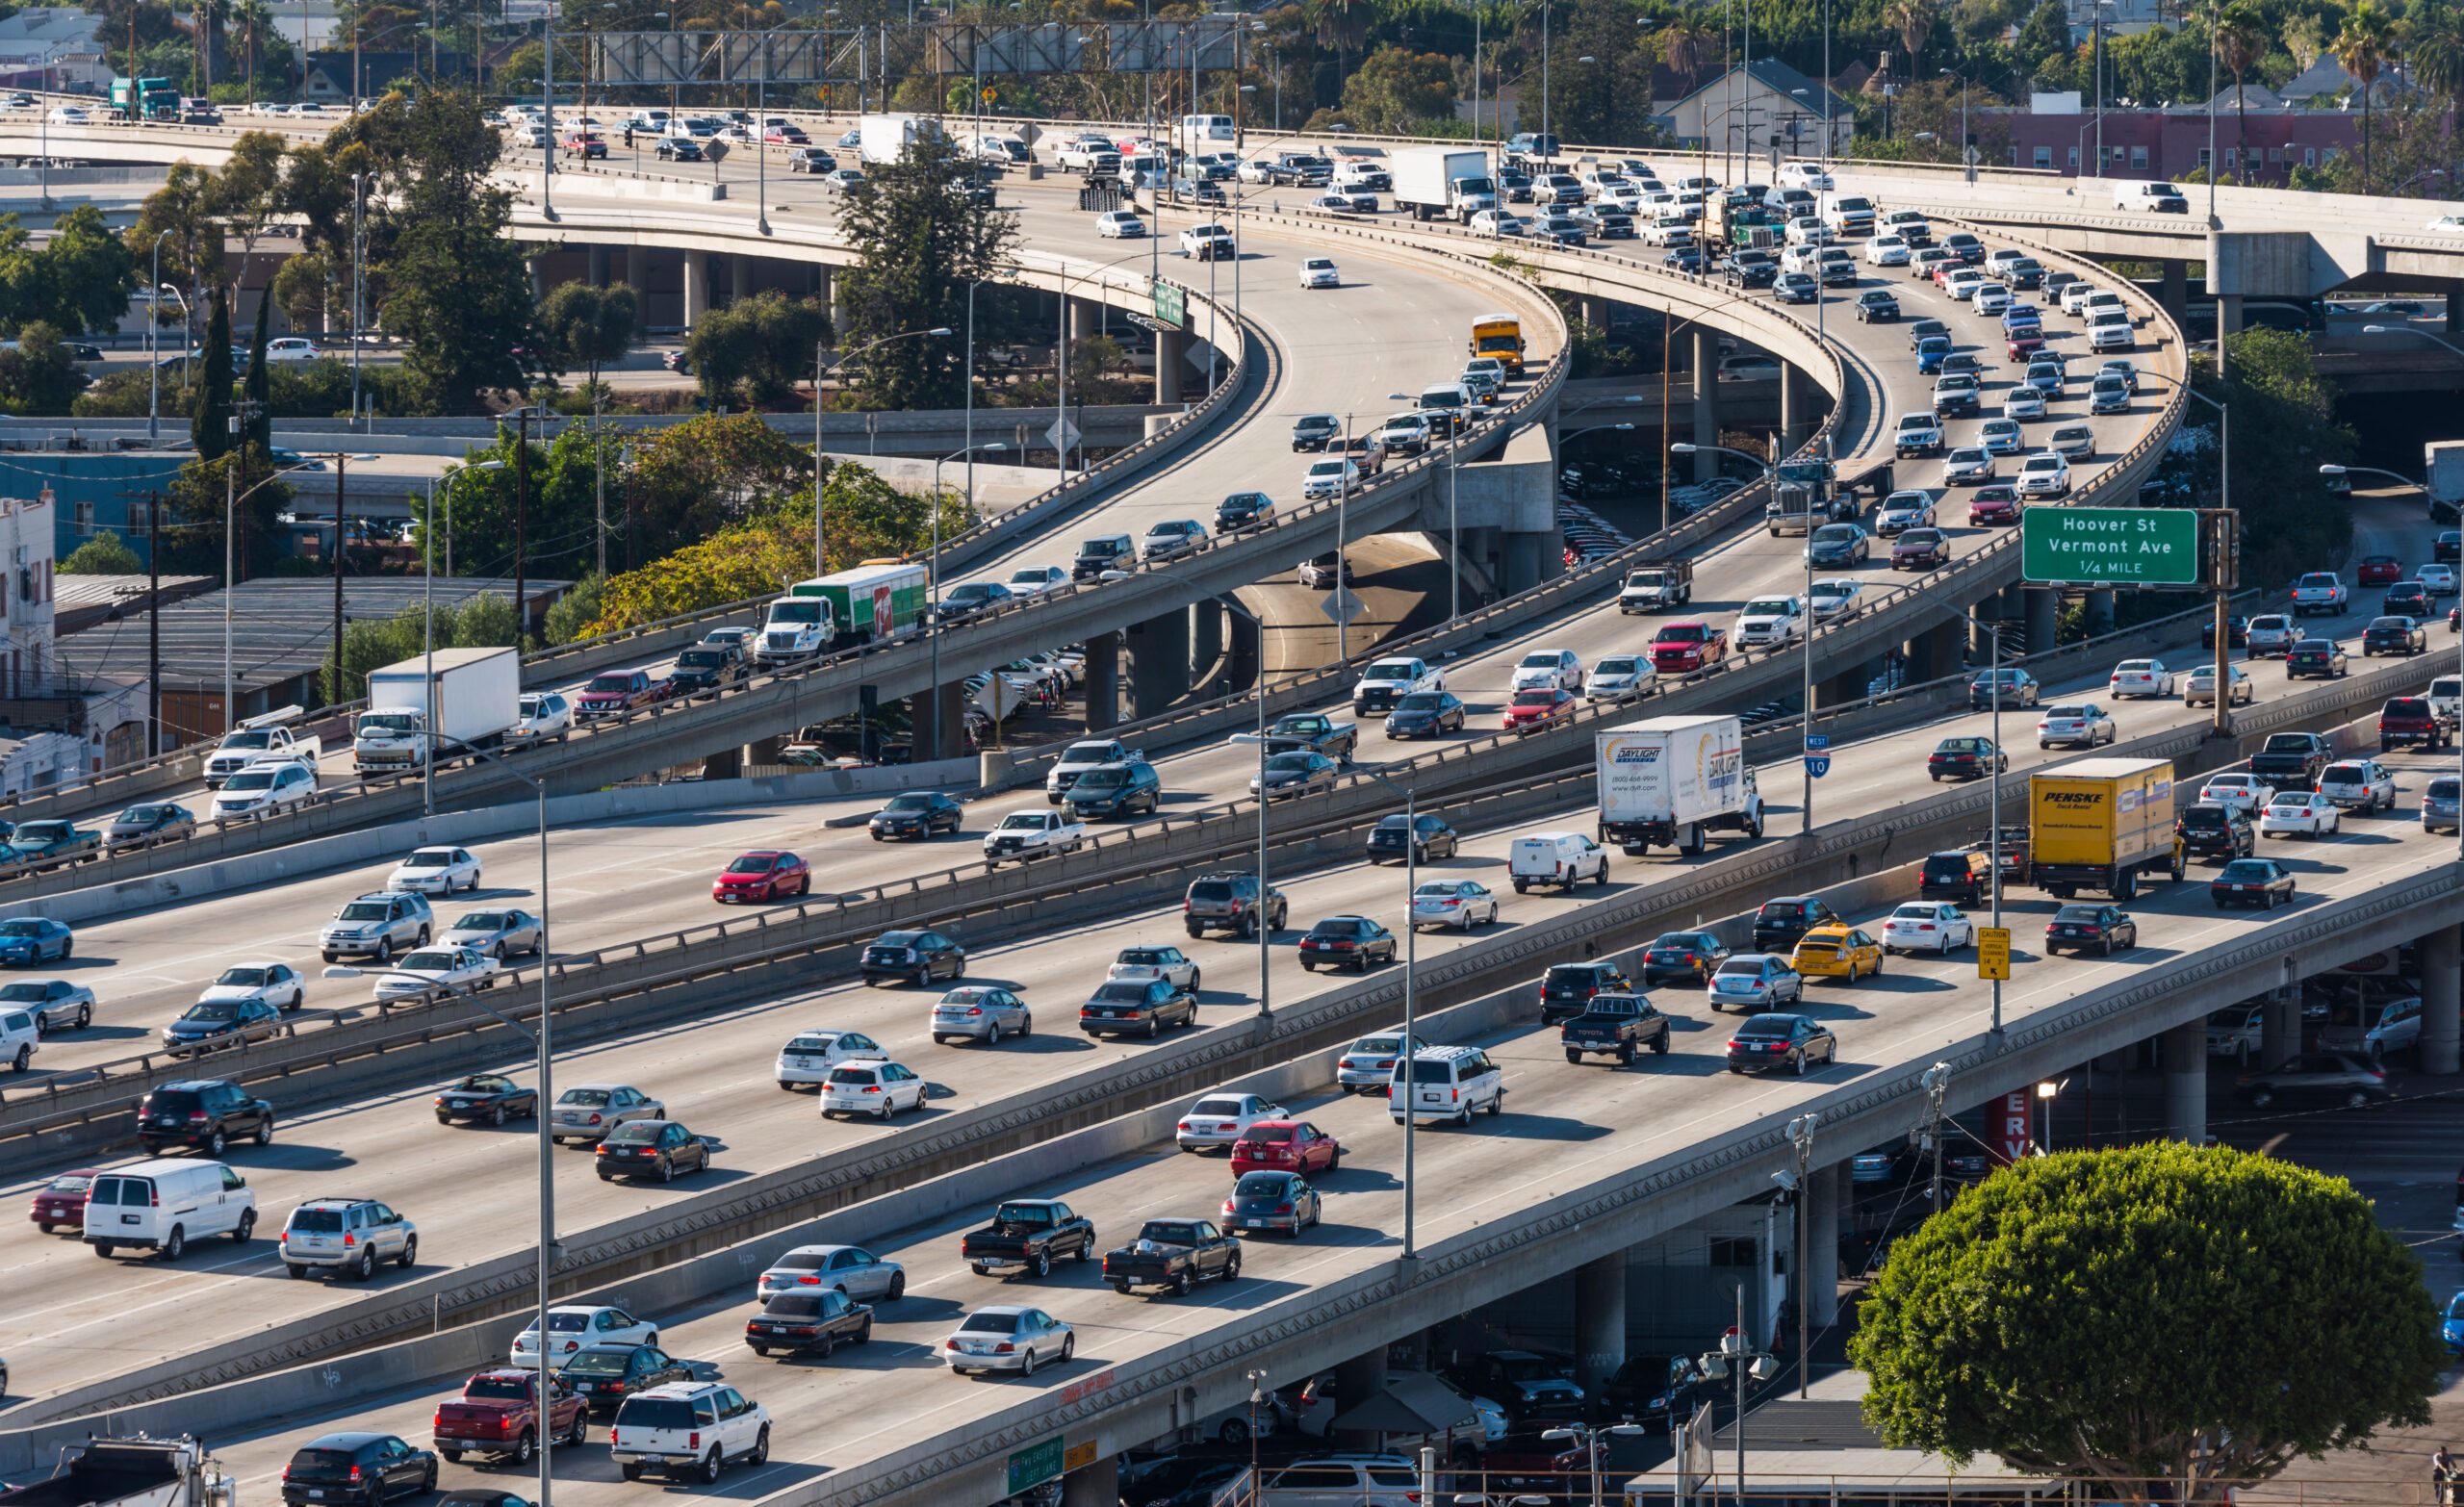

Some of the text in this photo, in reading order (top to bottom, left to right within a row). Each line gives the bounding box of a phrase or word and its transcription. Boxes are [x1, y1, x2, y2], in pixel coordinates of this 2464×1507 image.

[2063, 517, 2157, 532] Hoover St
[2048, 538, 2171, 554] Vermont Ave
[2080, 560, 2143, 575] 1/4 MILE
[1617, 749, 1662, 758] DAYLIGHT
[1708, 754, 1741, 779] DAYLIGHT
[1810, 761, 1825, 773] 10
[2043, 792, 2103, 803] PENSKE
